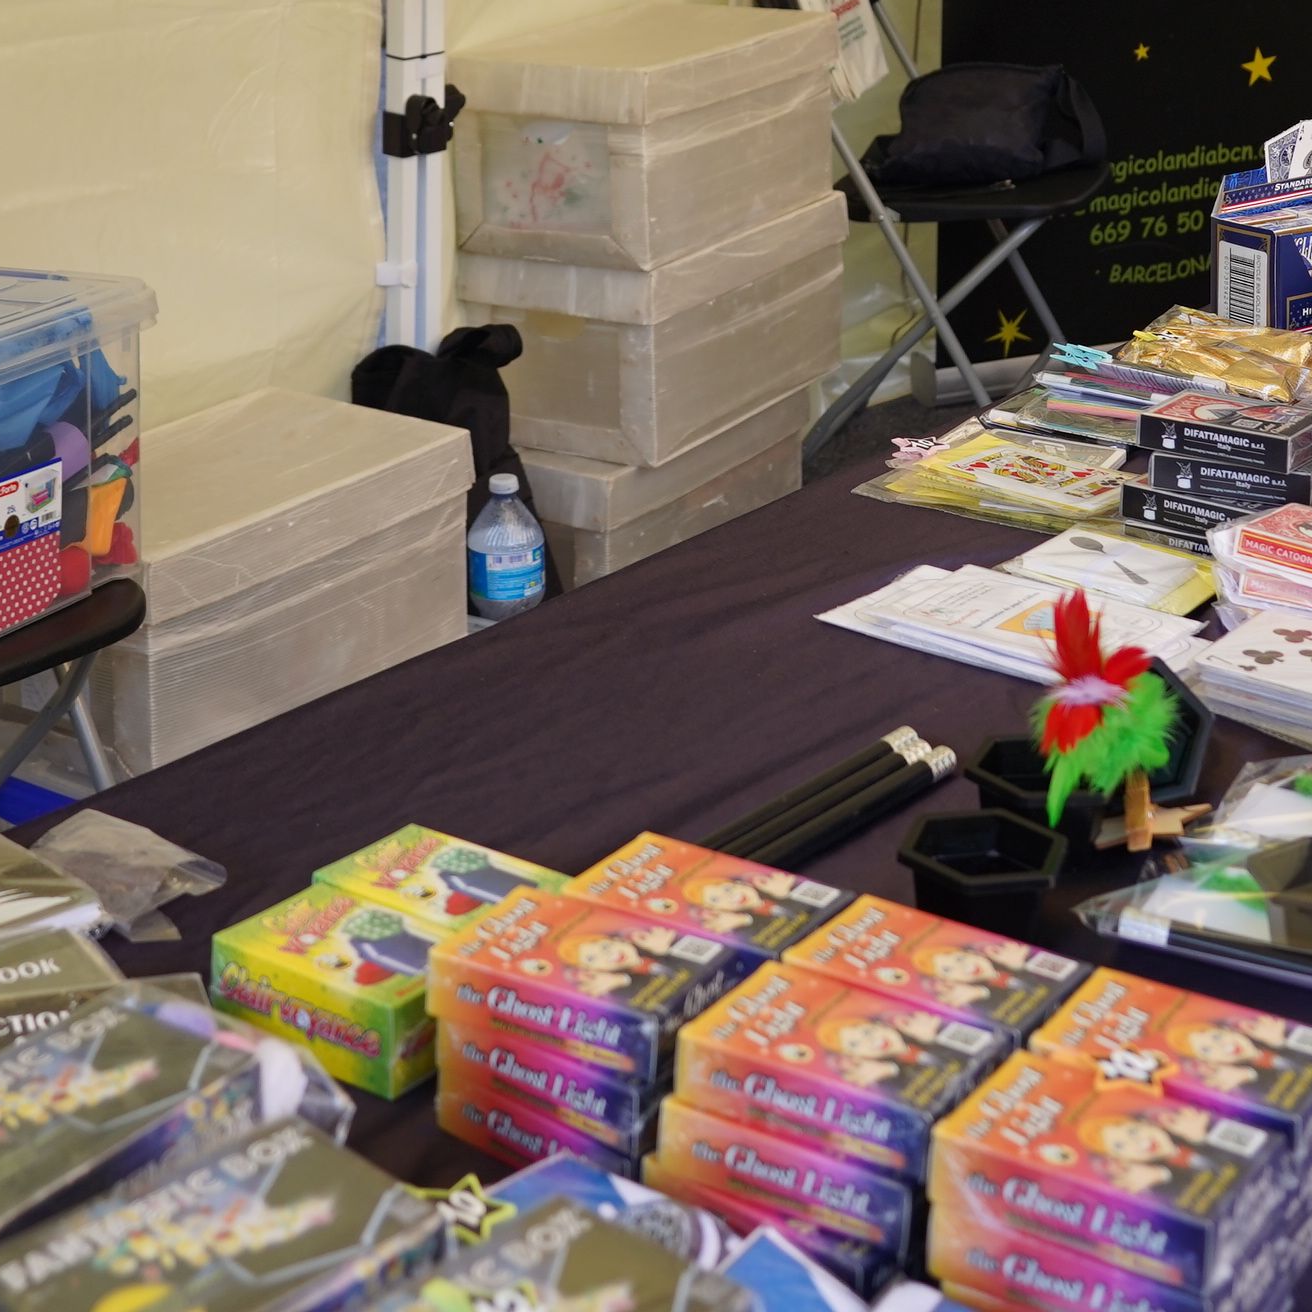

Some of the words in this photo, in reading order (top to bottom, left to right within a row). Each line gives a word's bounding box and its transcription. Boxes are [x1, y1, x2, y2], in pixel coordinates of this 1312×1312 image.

[1090, 219, 1131, 246] 669
[1140, 215, 1168, 238] 76
[1176, 209, 1204, 233] 50
[1184, 427, 1250, 448] DIFATTAMAGIC
[1217, 442, 1232, 452] Italy
[1200, 466, 1270, 485] DIFATTAMAGIC
[1236, 480, 1251, 490] Italy
[1163, 499, 1226, 521] DIFATTAMAGIC
[1194, 515, 1209, 526] Italy
[1245, 538, 1274, 556] MAGIC
